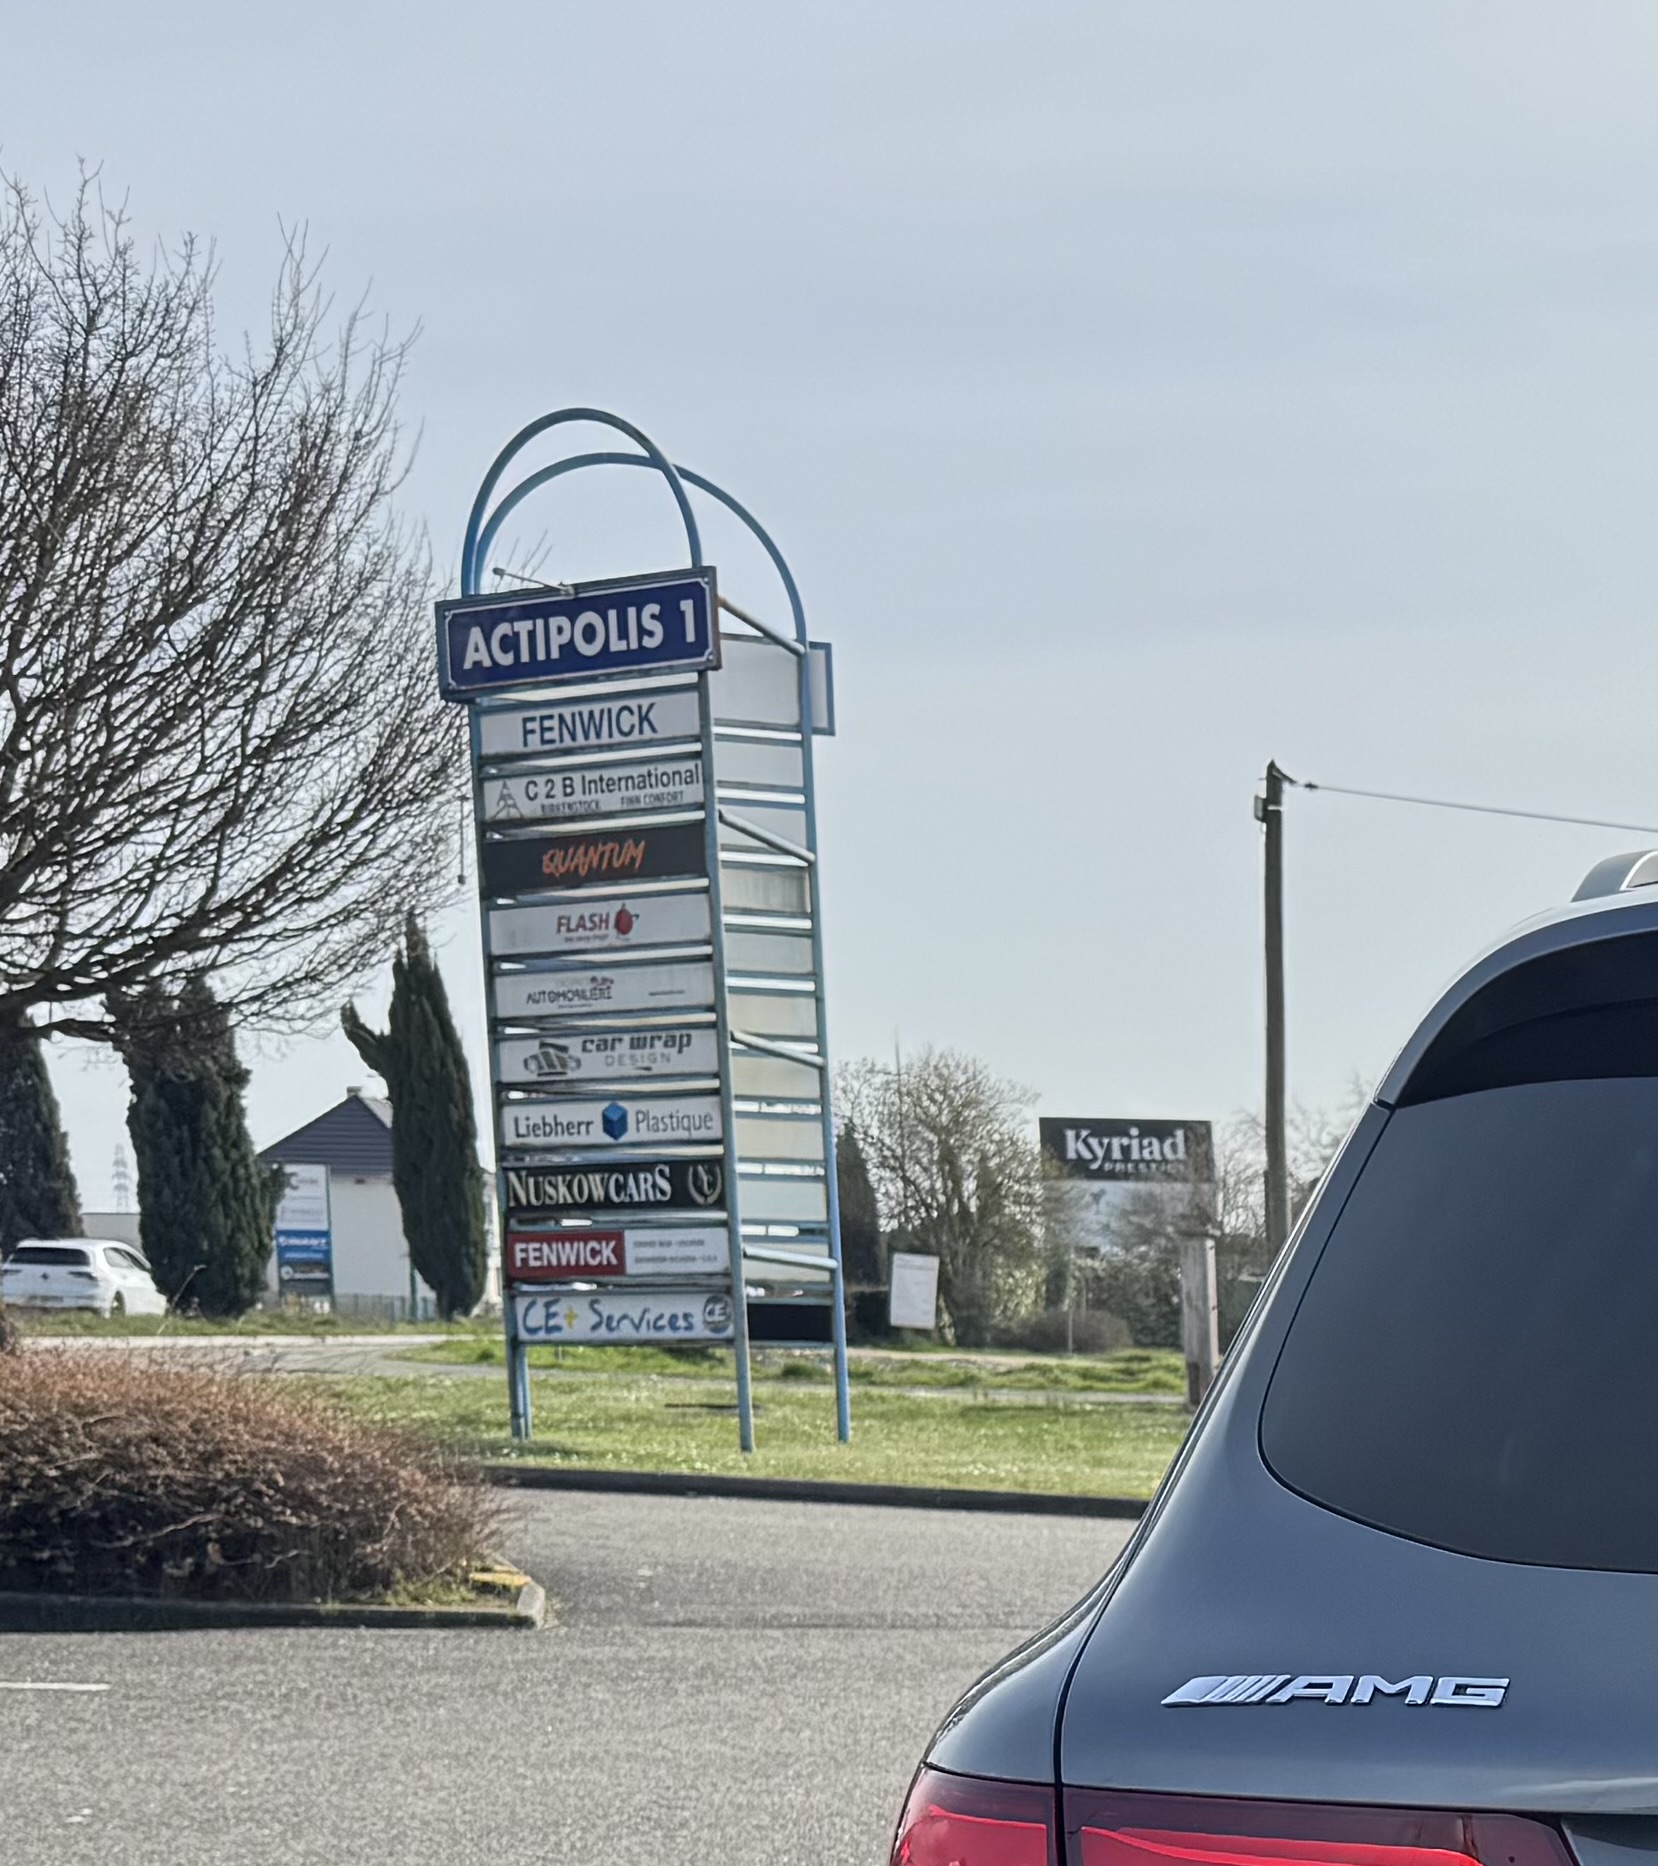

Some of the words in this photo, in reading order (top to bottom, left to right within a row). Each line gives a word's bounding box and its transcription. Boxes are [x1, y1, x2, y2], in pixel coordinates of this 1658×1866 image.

[463, 603, 664, 671] ACTIPOLIS
[679, 599, 696, 643] 1
[521, 702, 659, 748] FENWICK
[525, 780, 539, 801] C
[544, 778, 556, 799] 2
[562, 776, 575, 797] B
[581, 763, 700, 796] International
[542, 838, 646, 878] QUANTUM
[556, 912, 610, 934] FLASH
[581, 1037, 624, 1053] car
[629, 1033, 692, 1055] wrap
[604, 1052, 672, 1067] DESIGN
[513, 1113, 594, 1139] Liebherr
[634, 1110, 714, 1136] Plastique
[1064, 1127, 1187, 1170] Kyriad
[515, 1240, 618, 1268] FENWICK
[589, 1299, 694, 1333] Services
[1265, 1674, 1511, 1707] AMG
